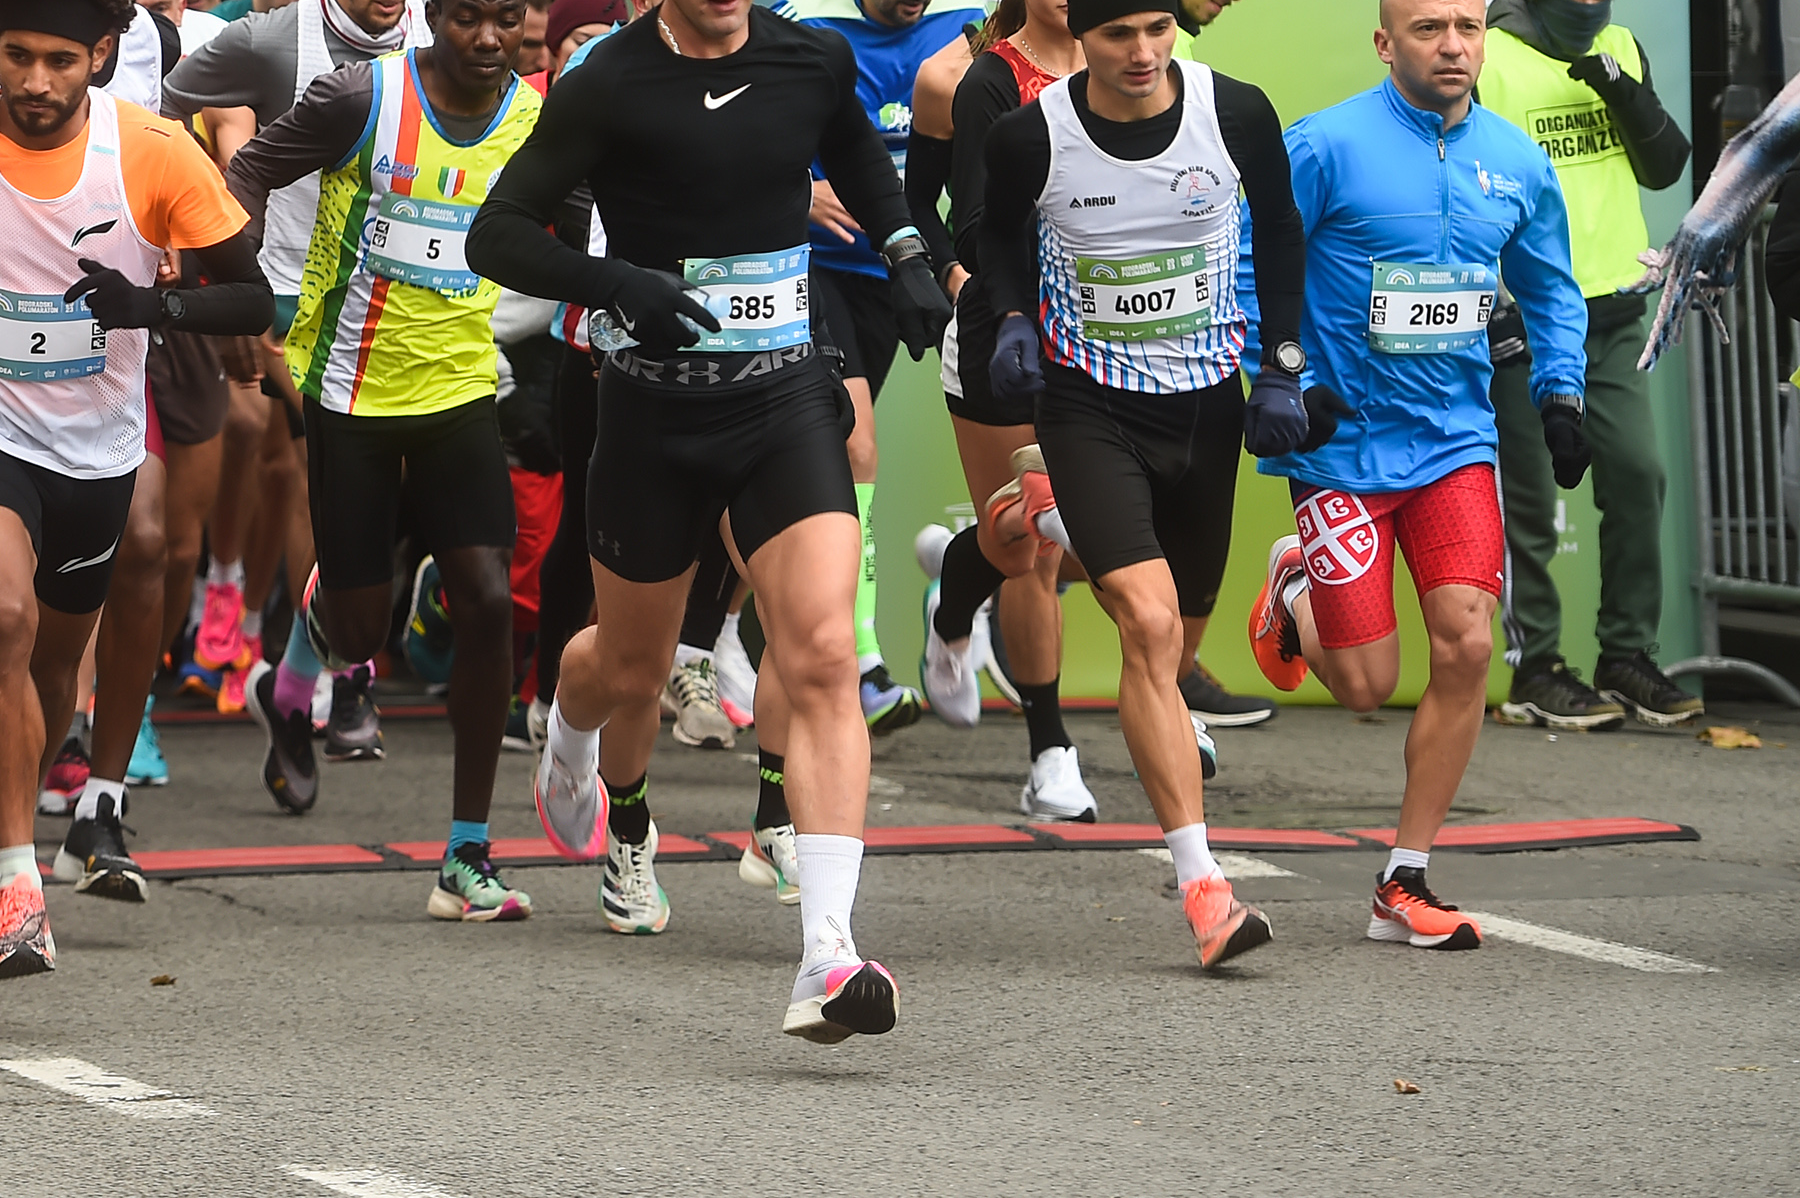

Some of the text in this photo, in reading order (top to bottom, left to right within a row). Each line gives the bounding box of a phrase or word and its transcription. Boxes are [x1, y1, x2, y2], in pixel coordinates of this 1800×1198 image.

[1083, 195, 1116, 207] ARDU
[426, 238, 442, 260] 5
[1115, 288, 1176, 315] 4007
[1409, 303, 1458, 325] 2169
[707, 337, 725, 346] IDEA
[1109, 329, 1125, 337] IDEA
[30, 332, 46, 354] 2
[1395, 342, 1410, 350] IDEA
